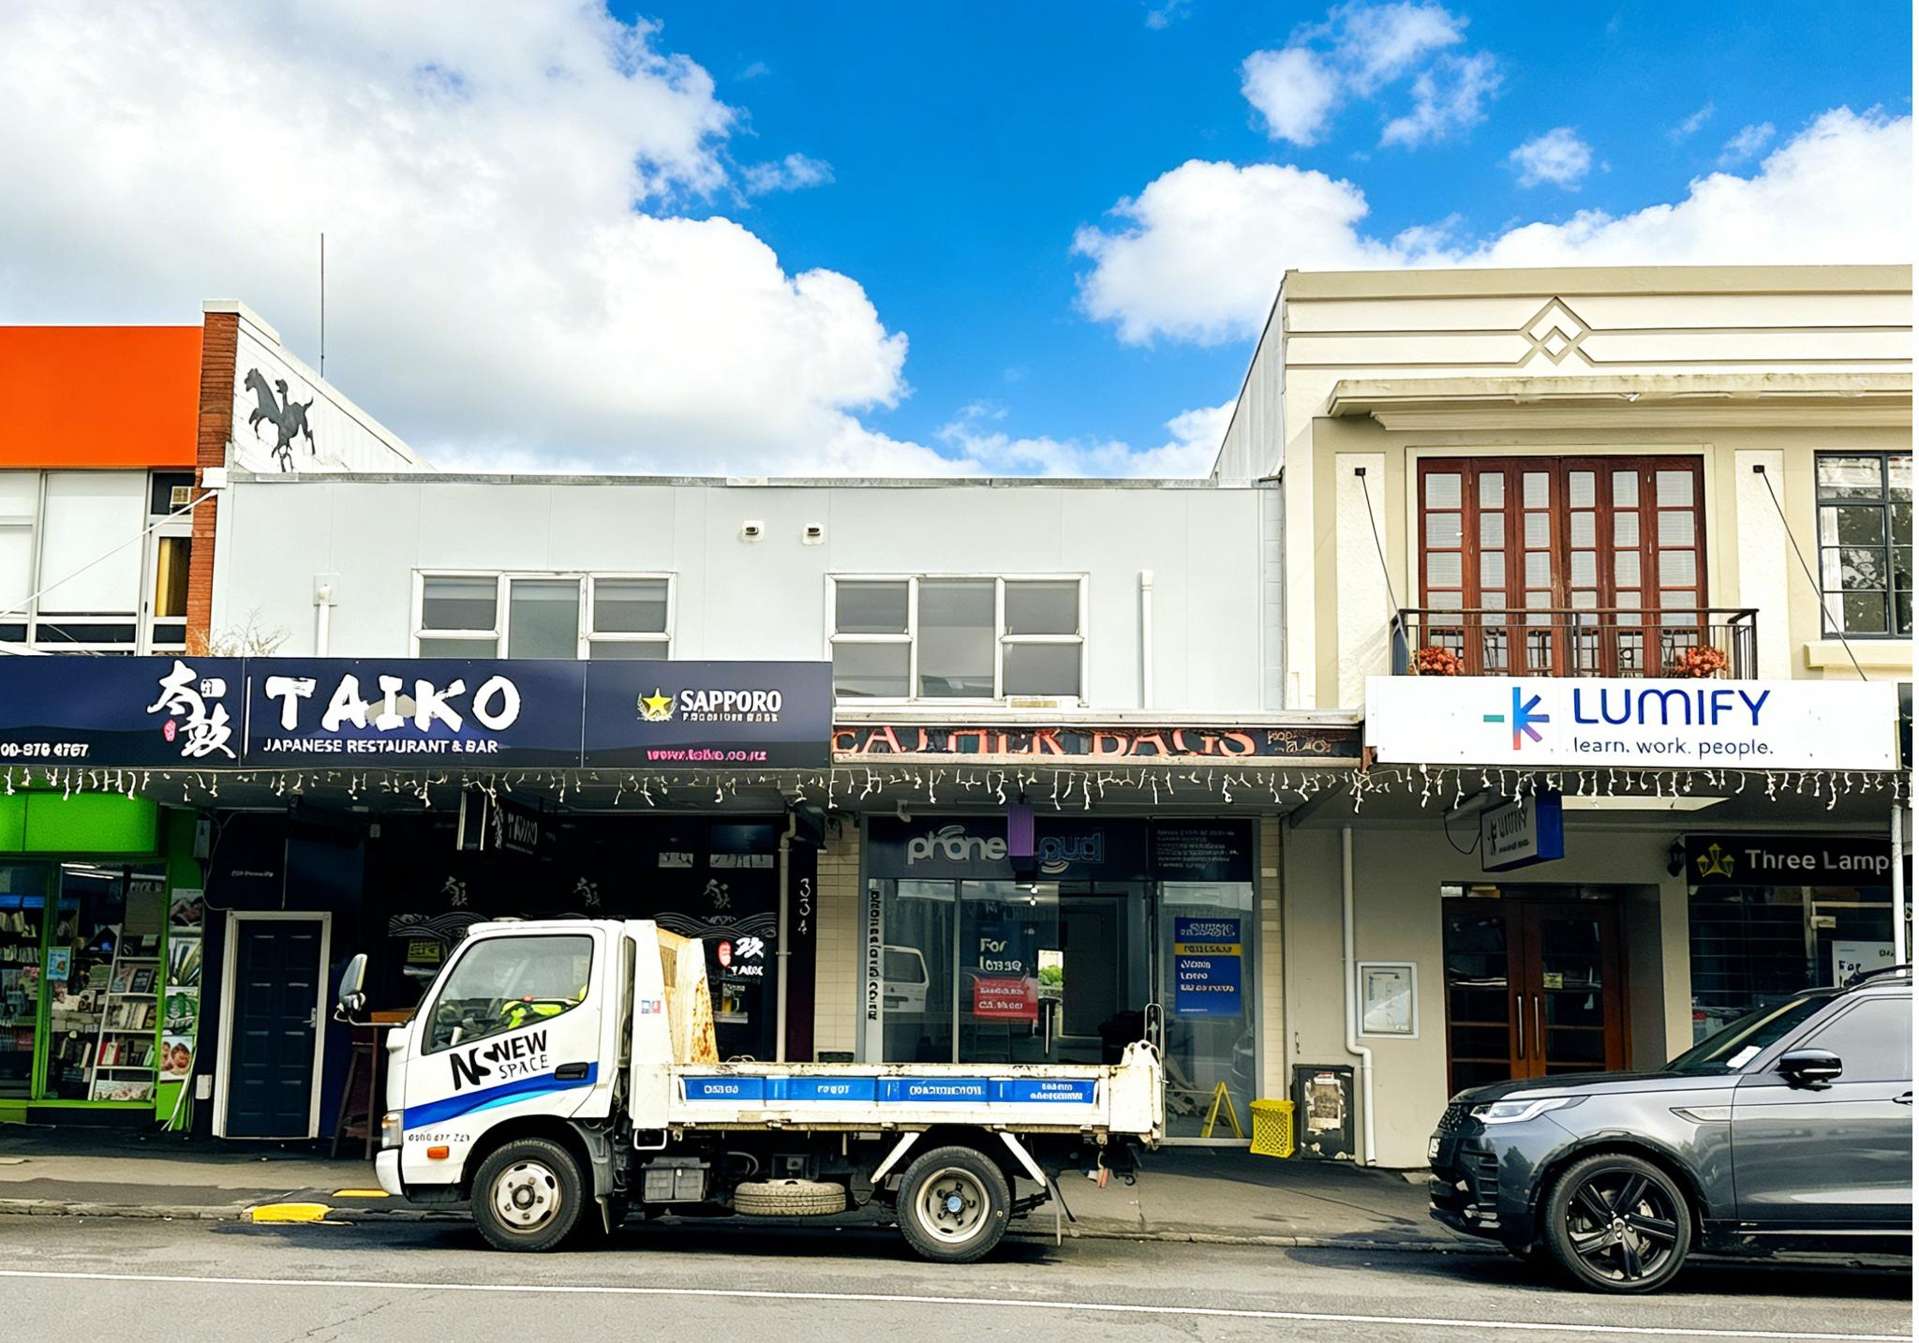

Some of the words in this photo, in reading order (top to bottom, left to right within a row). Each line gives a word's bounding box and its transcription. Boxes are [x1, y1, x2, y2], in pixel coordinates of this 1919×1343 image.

[265, 674, 521, 732] TAIKO
[680, 690, 782, 712] SAPPORO
[1573, 688, 1771, 726] LUMIFY
[263, 738, 343, 753] JAPANESE
[347, 739, 449, 754] RESTAURANT
[452, 740, 464, 754] &
[465, 740, 498, 754] BAR
[1573, 737, 1630, 753] learn.
[1636, 738, 1691, 754] work.
[1698, 739, 1773, 760] people.
[907, 830, 1007, 865] phone
[1744, 850, 1816, 870] Three
[492, 1030, 547, 1062] NEW
[499, 1054, 550, 1079] SPACE
